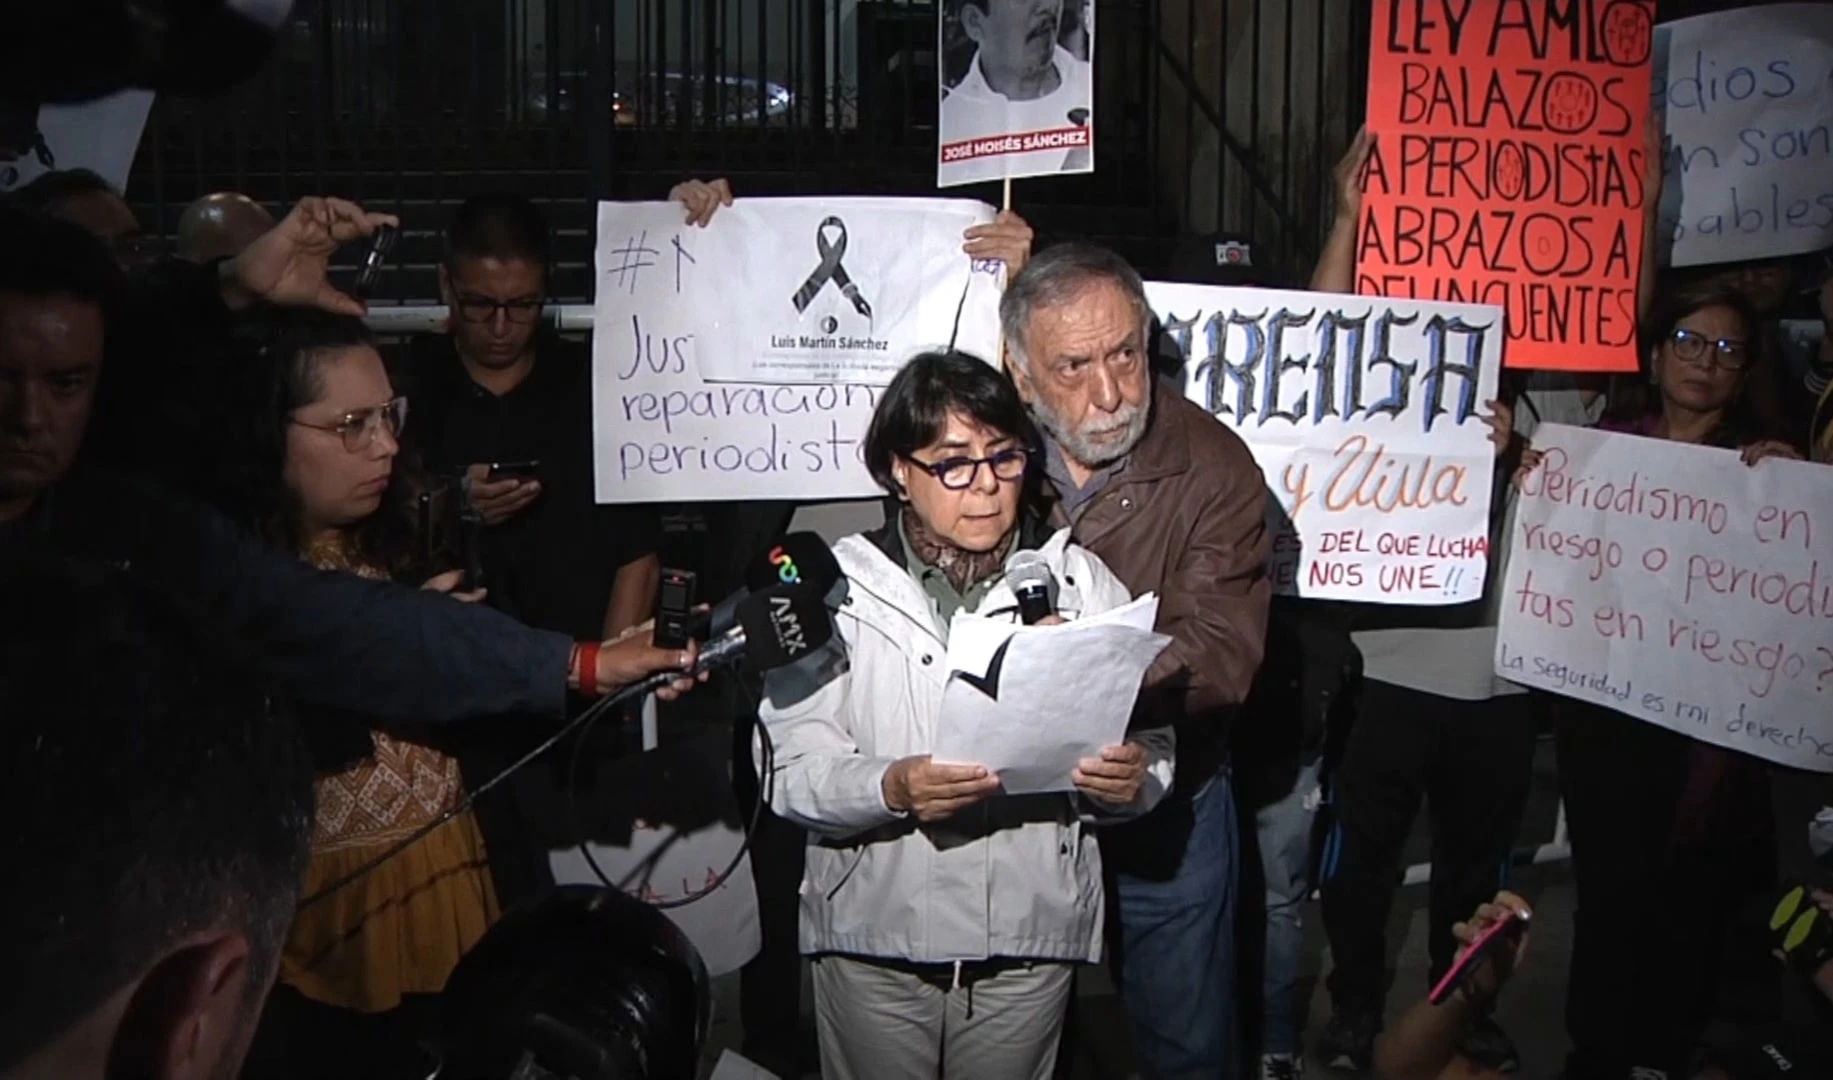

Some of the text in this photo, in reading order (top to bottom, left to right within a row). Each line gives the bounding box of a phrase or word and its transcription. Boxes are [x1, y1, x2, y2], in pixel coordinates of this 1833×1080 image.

[1387, 0, 1472, 56] LEY
[1399, 62, 1633, 136] BALAZOS
[943, 129, 1087, 161] JOSÉ MOISÉS SÁNCHEZ
[1361, 136, 1390, 195] A
[1738, 125, 1831, 167] son
[1358, 205, 1630, 280] ABRAZOS A
[618, 314, 694, 381] Jus
[770, 334, 889, 351] Luis Martín Sánchez
[1521, 446, 1812, 549] Periodismo en
[1318, 529, 1370, 554] DEL
[1376, 532, 1420, 557] QUE
[1426, 533, 1489, 559] LUCHA
[1522, 522, 1623, 581] riesgo
[1642, 547, 1668, 573] o
[1308, 560, 1363, 588] NOS
[1515, 570, 1575, 628] tas
[1593, 606, 1645, 641] en
[1533, 655, 1632, 702] seguridad
[1642, 692, 1666, 713] es
